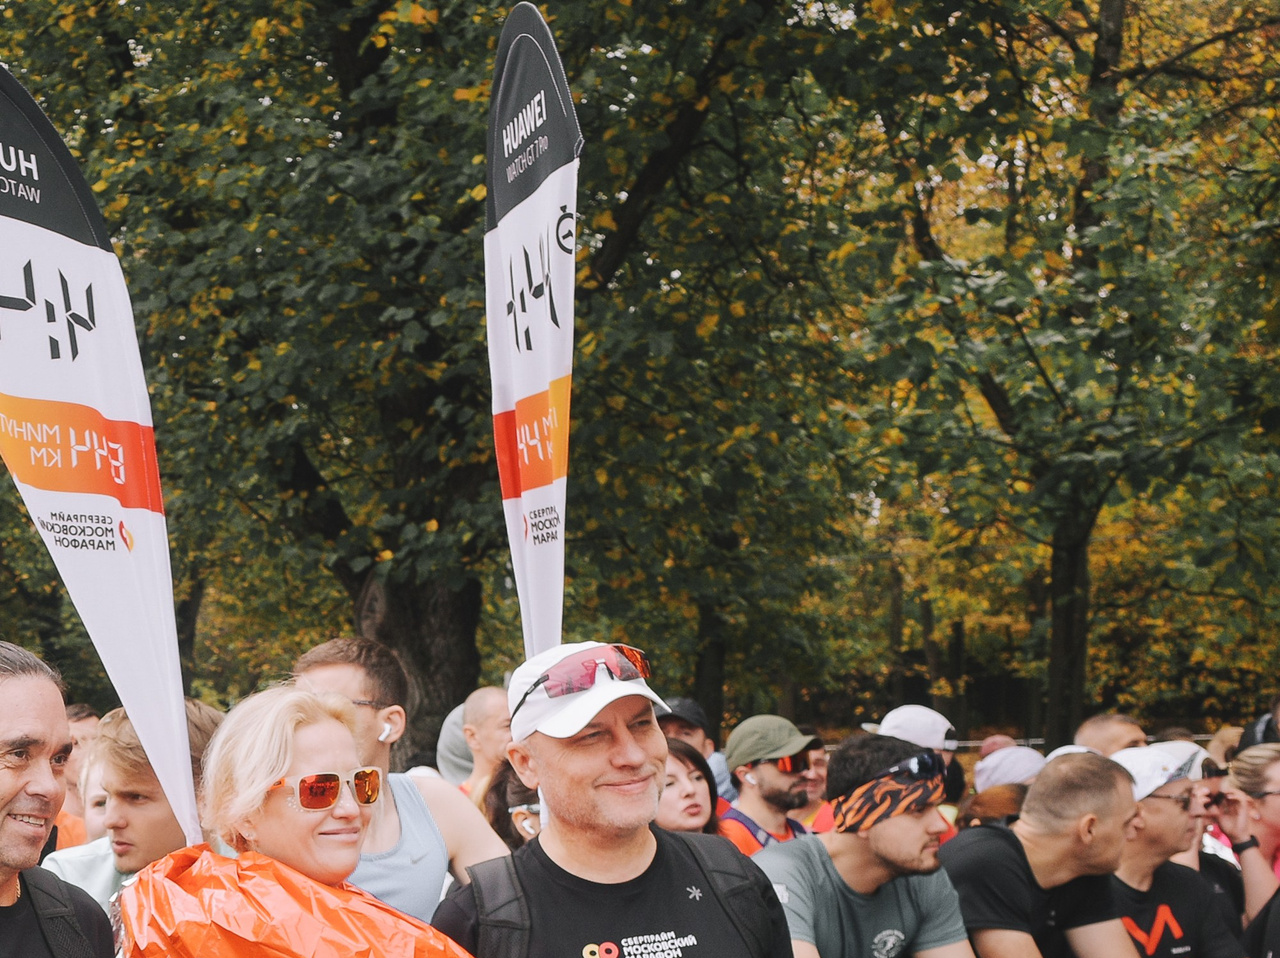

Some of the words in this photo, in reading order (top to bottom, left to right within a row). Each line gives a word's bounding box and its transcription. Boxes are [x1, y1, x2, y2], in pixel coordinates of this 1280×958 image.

[503, 90, 547, 158] HUAWEI
[620, 931, 676, 947] СБЕРПРАЙМ
[622, 934, 698, 956] МОСКОВСКИЙ
